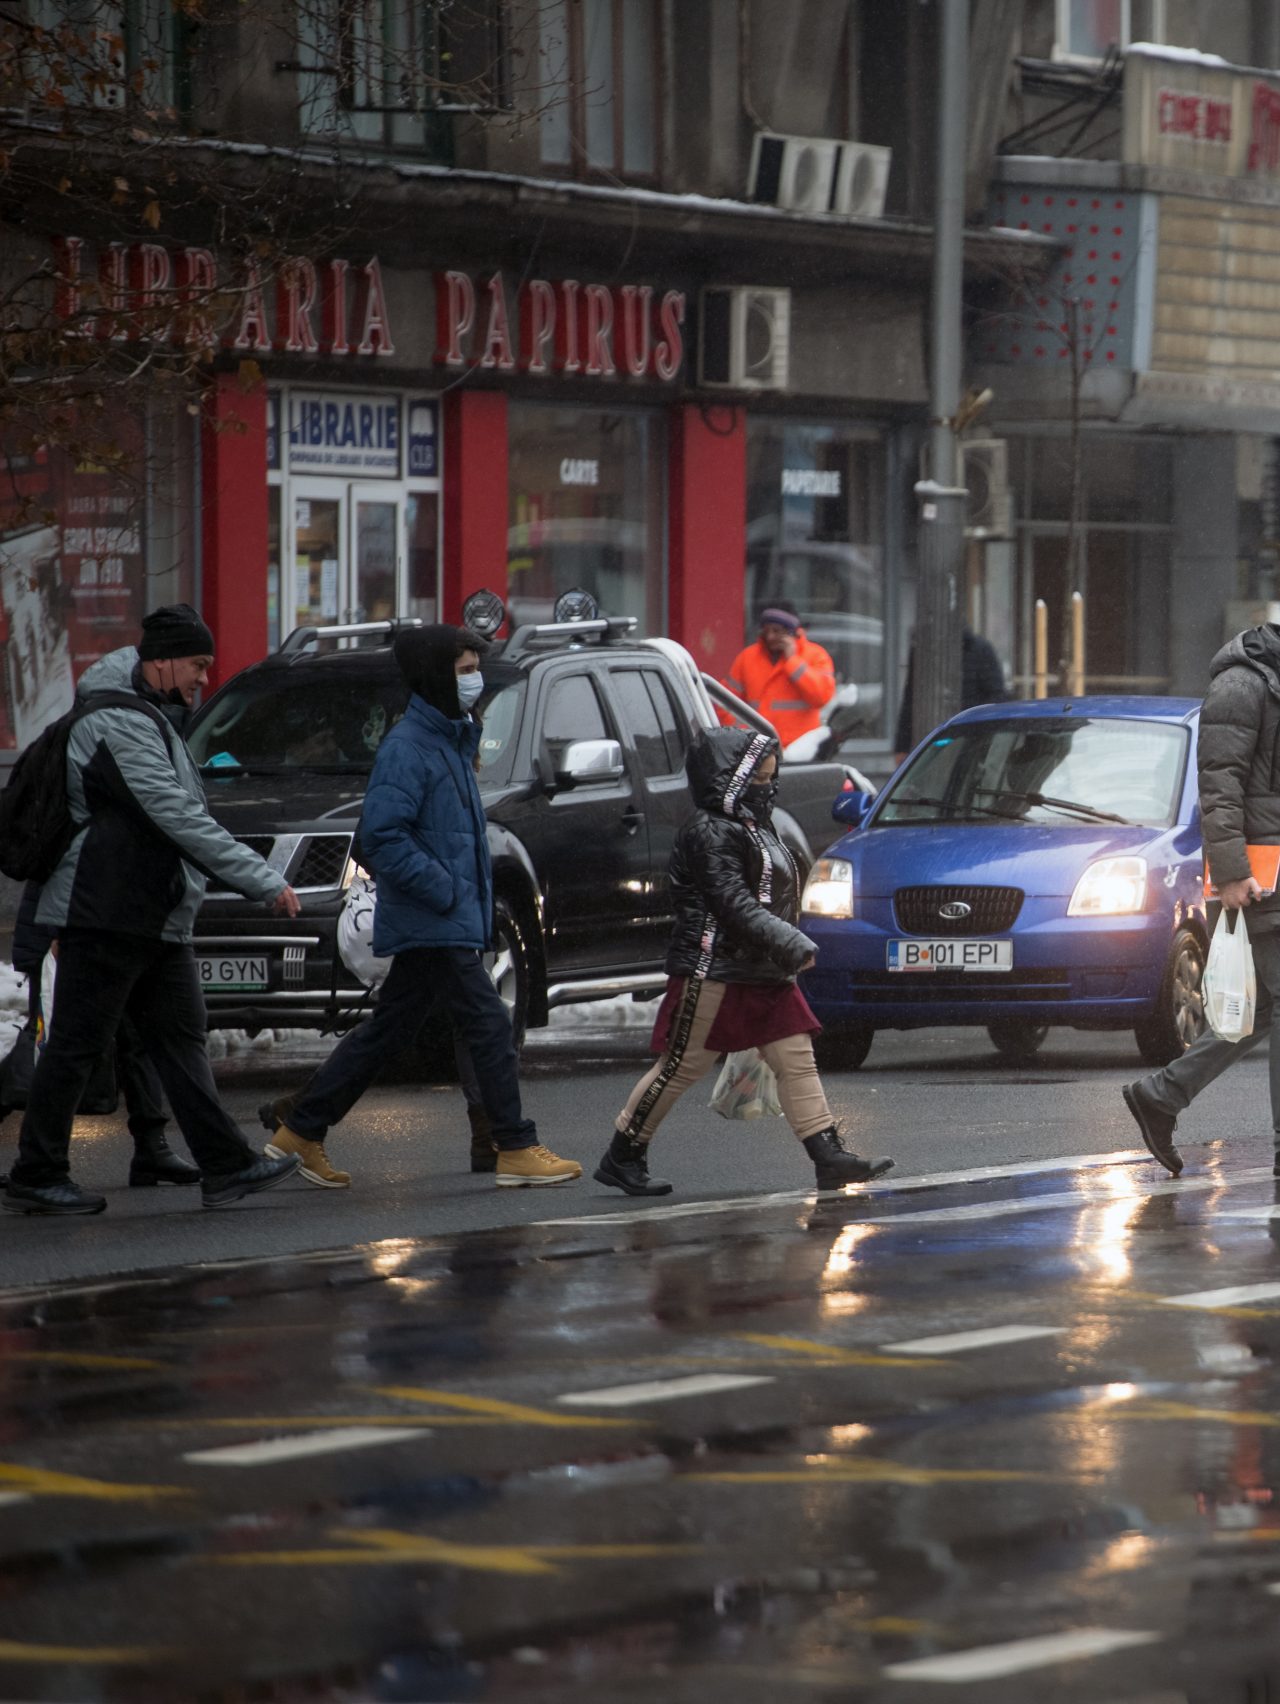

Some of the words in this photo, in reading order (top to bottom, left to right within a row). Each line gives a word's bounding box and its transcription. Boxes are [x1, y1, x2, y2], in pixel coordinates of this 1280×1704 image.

[436, 269, 686, 381] PAPIRUS
[289, 399, 397, 449] LIBRARIE
[943, 905, 966, 915] KIA
[906, 944, 920, 964] B
[928, 944, 955, 964] 101
[963, 944, 998, 964] EPI
[219, 960, 265, 982] GYN
